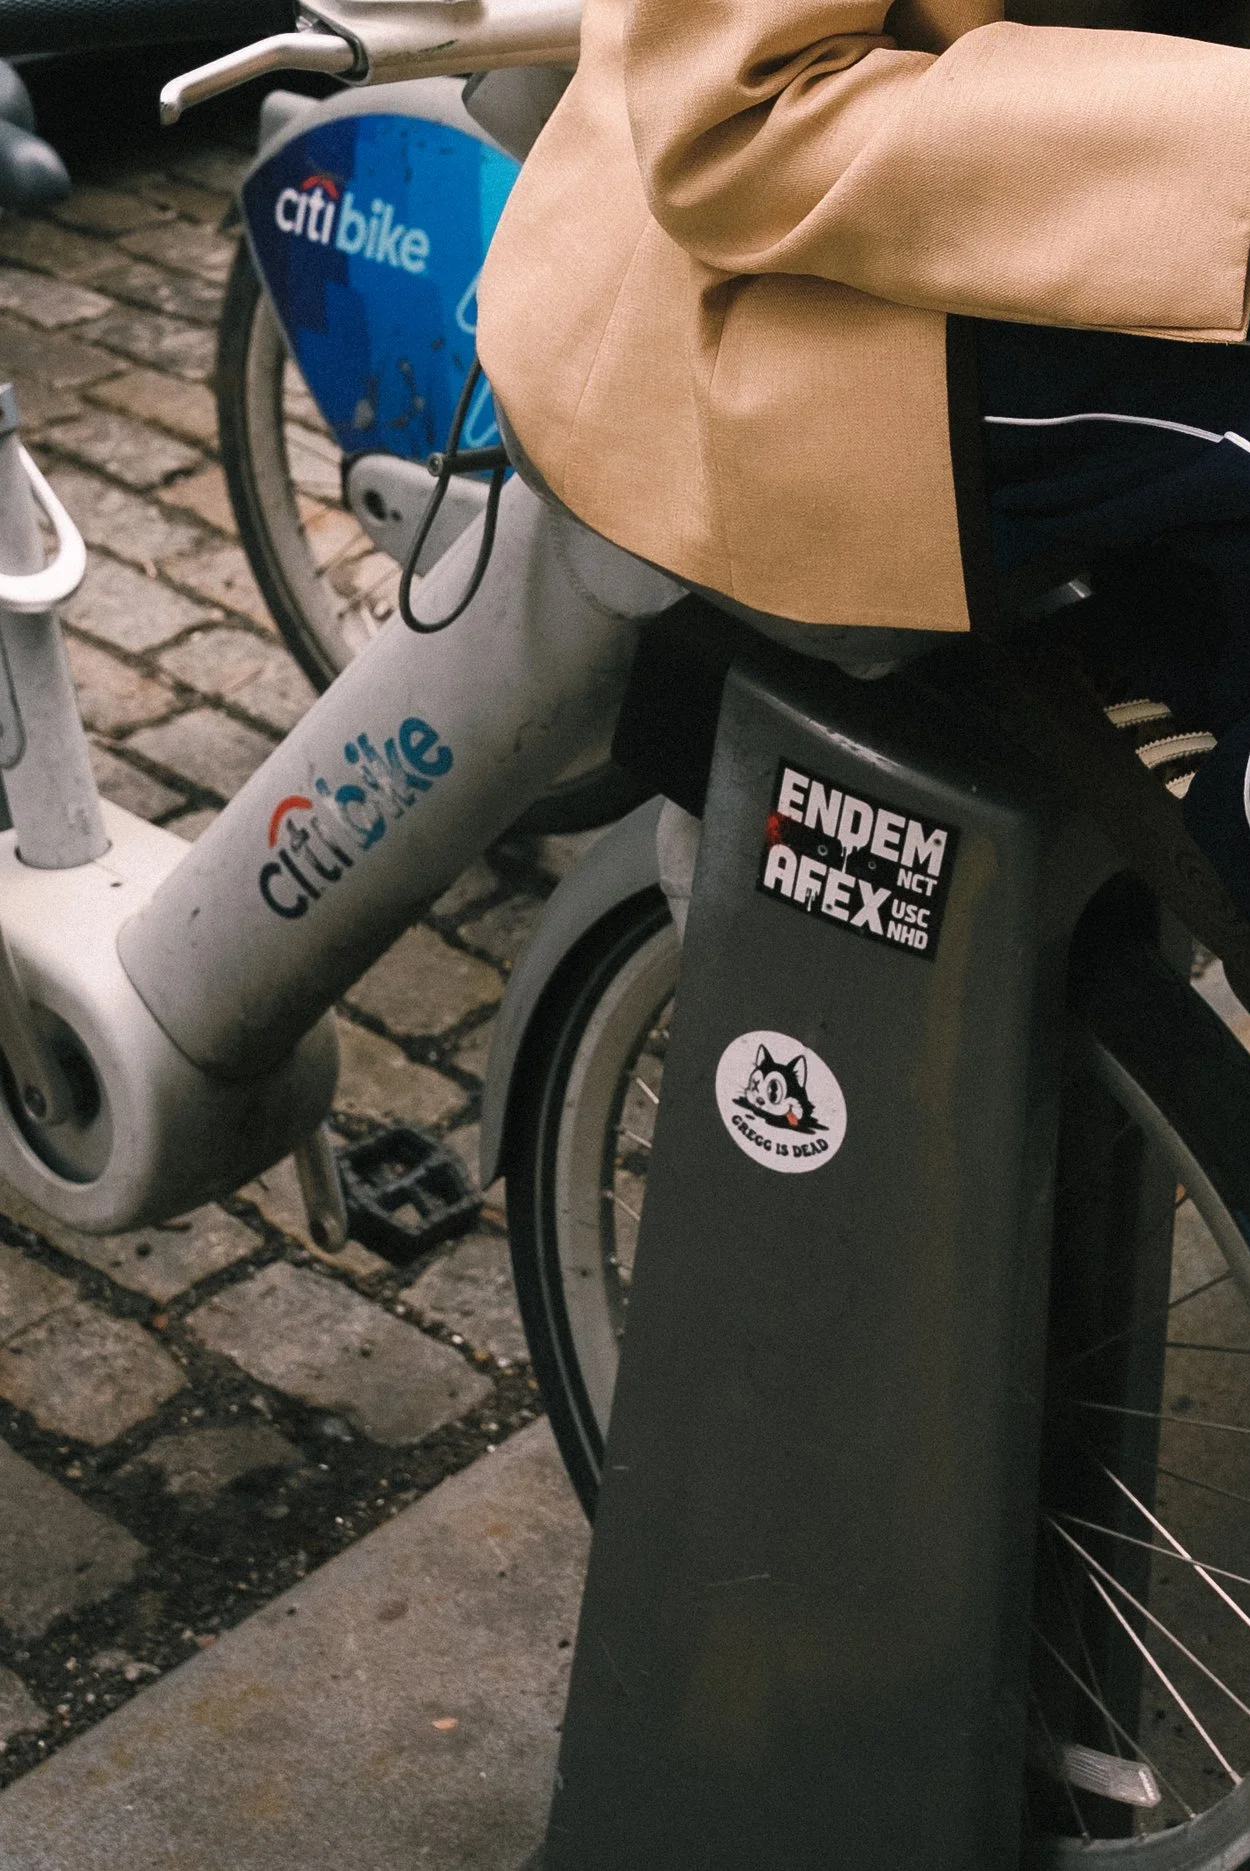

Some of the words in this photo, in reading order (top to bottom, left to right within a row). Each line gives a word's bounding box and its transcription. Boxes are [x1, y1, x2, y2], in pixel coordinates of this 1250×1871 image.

[777, 767, 948, 877] ENDEM
[763, 843, 892, 936] AFEX
[896, 868, 938, 897] NCT
[891, 898, 931, 929] USC
[886, 920, 929, 950] NHD
[731, 1114, 772, 1151] GREGG
[775, 1142, 789, 1156] IS
[792, 1138, 829, 1157] DEAD
